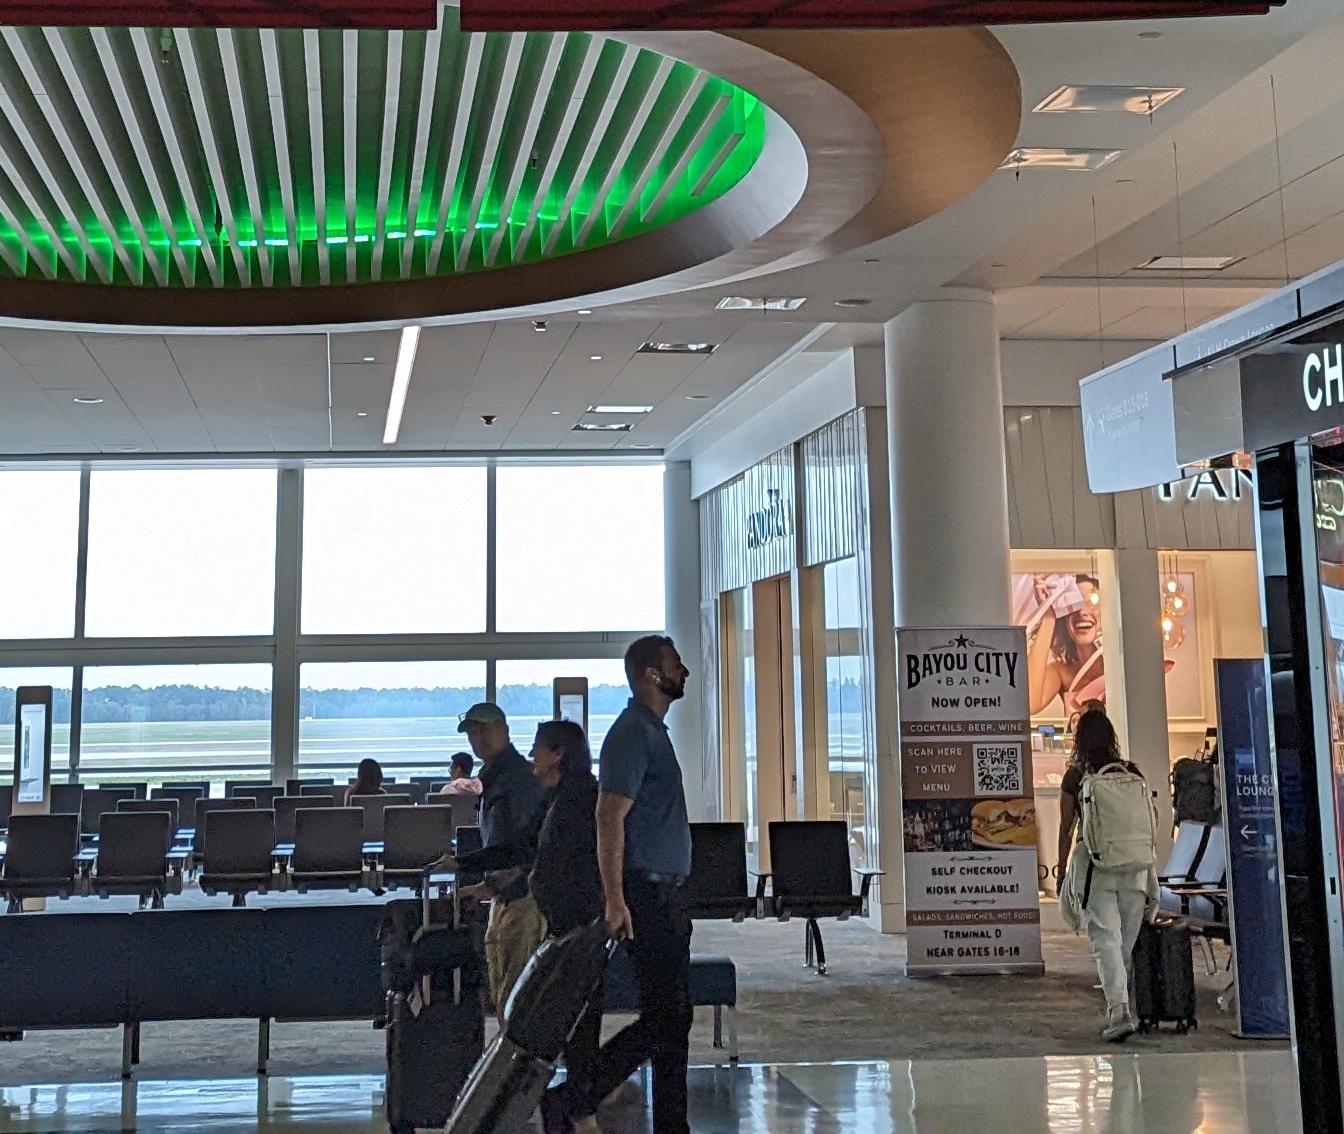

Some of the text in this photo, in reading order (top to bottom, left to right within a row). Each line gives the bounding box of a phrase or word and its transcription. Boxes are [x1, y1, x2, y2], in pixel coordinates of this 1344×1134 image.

[907, 651, 1019, 690] BAYOU CITY
[946, 677, 982, 687] BAR
[931, 696, 1001, 708] NOW OPEN!
[910, 724, 965, 733] COCKTAILS,
[998, 723, 1023, 731] WINE
[908, 747, 962, 757] SCAN HERE
[931, 764, 956, 774] VIEW
[922, 783, 950, 792] MENU
[931, 866, 1013, 876] SELF CHECKOUT
[926, 884, 1020, 895] KIOSK AVAILABLE!
[943, 929, 1002, 939] TERMINAL D
[926, 948, 954, 957] NEAR
[957, 947, 990, 957] GATES
